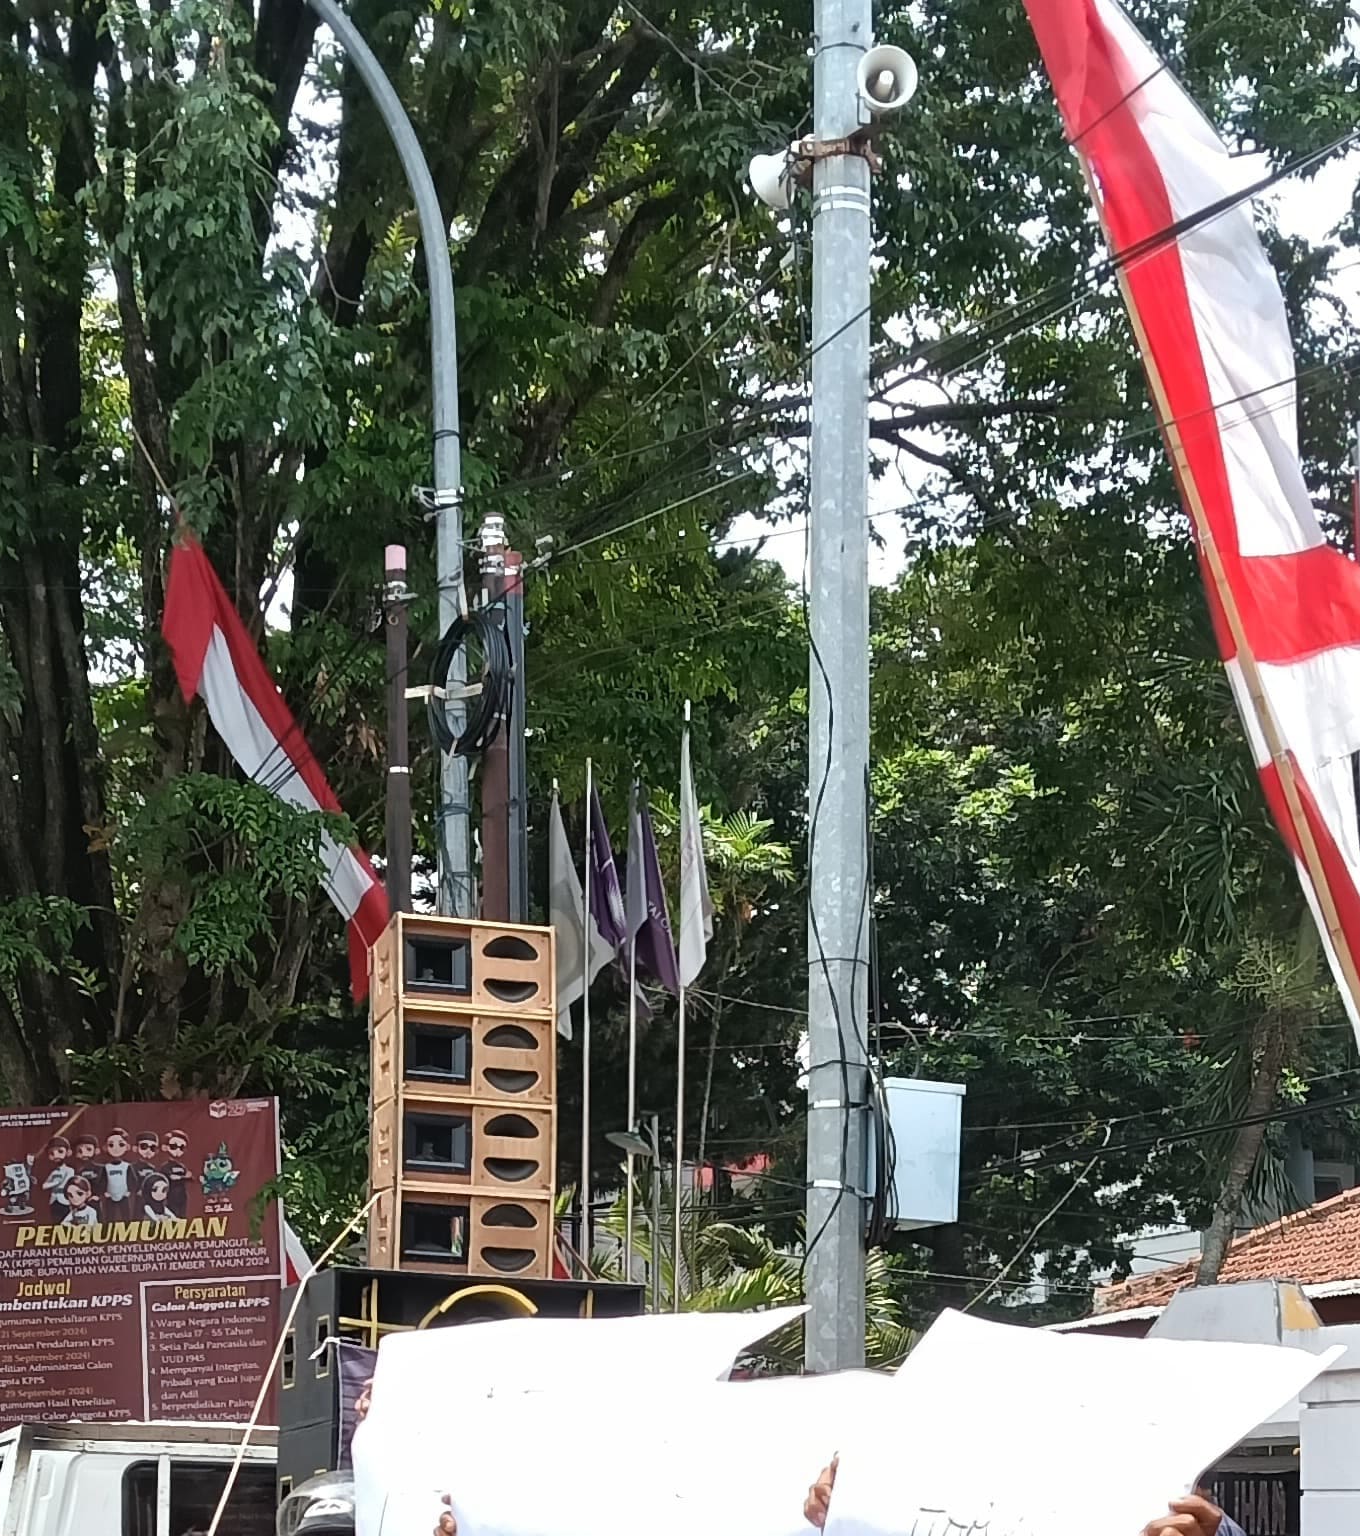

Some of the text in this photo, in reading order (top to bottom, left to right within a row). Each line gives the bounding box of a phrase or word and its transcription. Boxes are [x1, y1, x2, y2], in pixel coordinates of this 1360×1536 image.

[16, 1215, 229, 1248] PENGUMUMAN
[75, 1265, 97, 1275] DAN
[97, 1263, 130, 1274] WAKIL
[209, 1258, 244, 1269] TAHUN
[245, 1256, 271, 1267] 2024
[16, 1278, 71, 1298] Jadwal
[174, 1284, 247, 1301] Persyaratan
[91, 1294, 134, 1308] KPPS
[238, 1297, 271, 1308] KPPS
